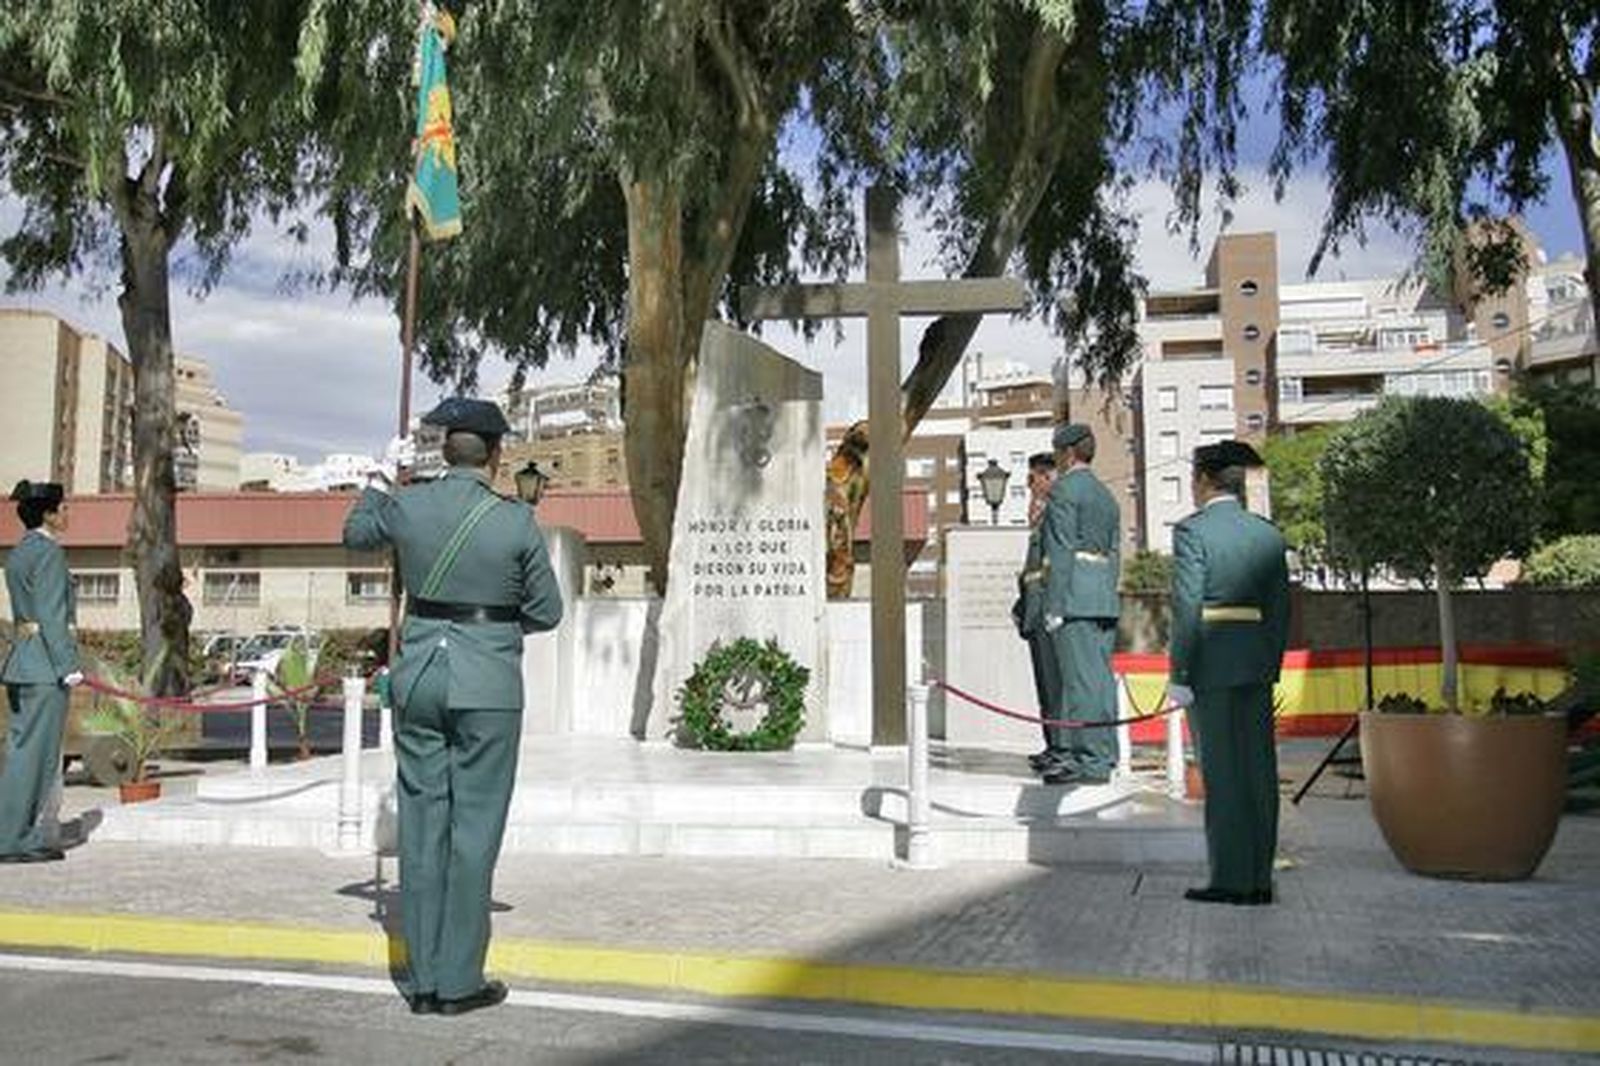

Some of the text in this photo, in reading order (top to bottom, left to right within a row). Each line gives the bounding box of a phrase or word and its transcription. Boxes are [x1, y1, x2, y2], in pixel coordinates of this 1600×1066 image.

[688, 518, 738, 533] HONOR
[757, 518, 810, 532] GLORIA
[710, 540, 787, 554] A LOS QUE
[693, 562, 807, 576] DIERON SU VIDA
[693, 583, 806, 598] POR LA PATRIA
